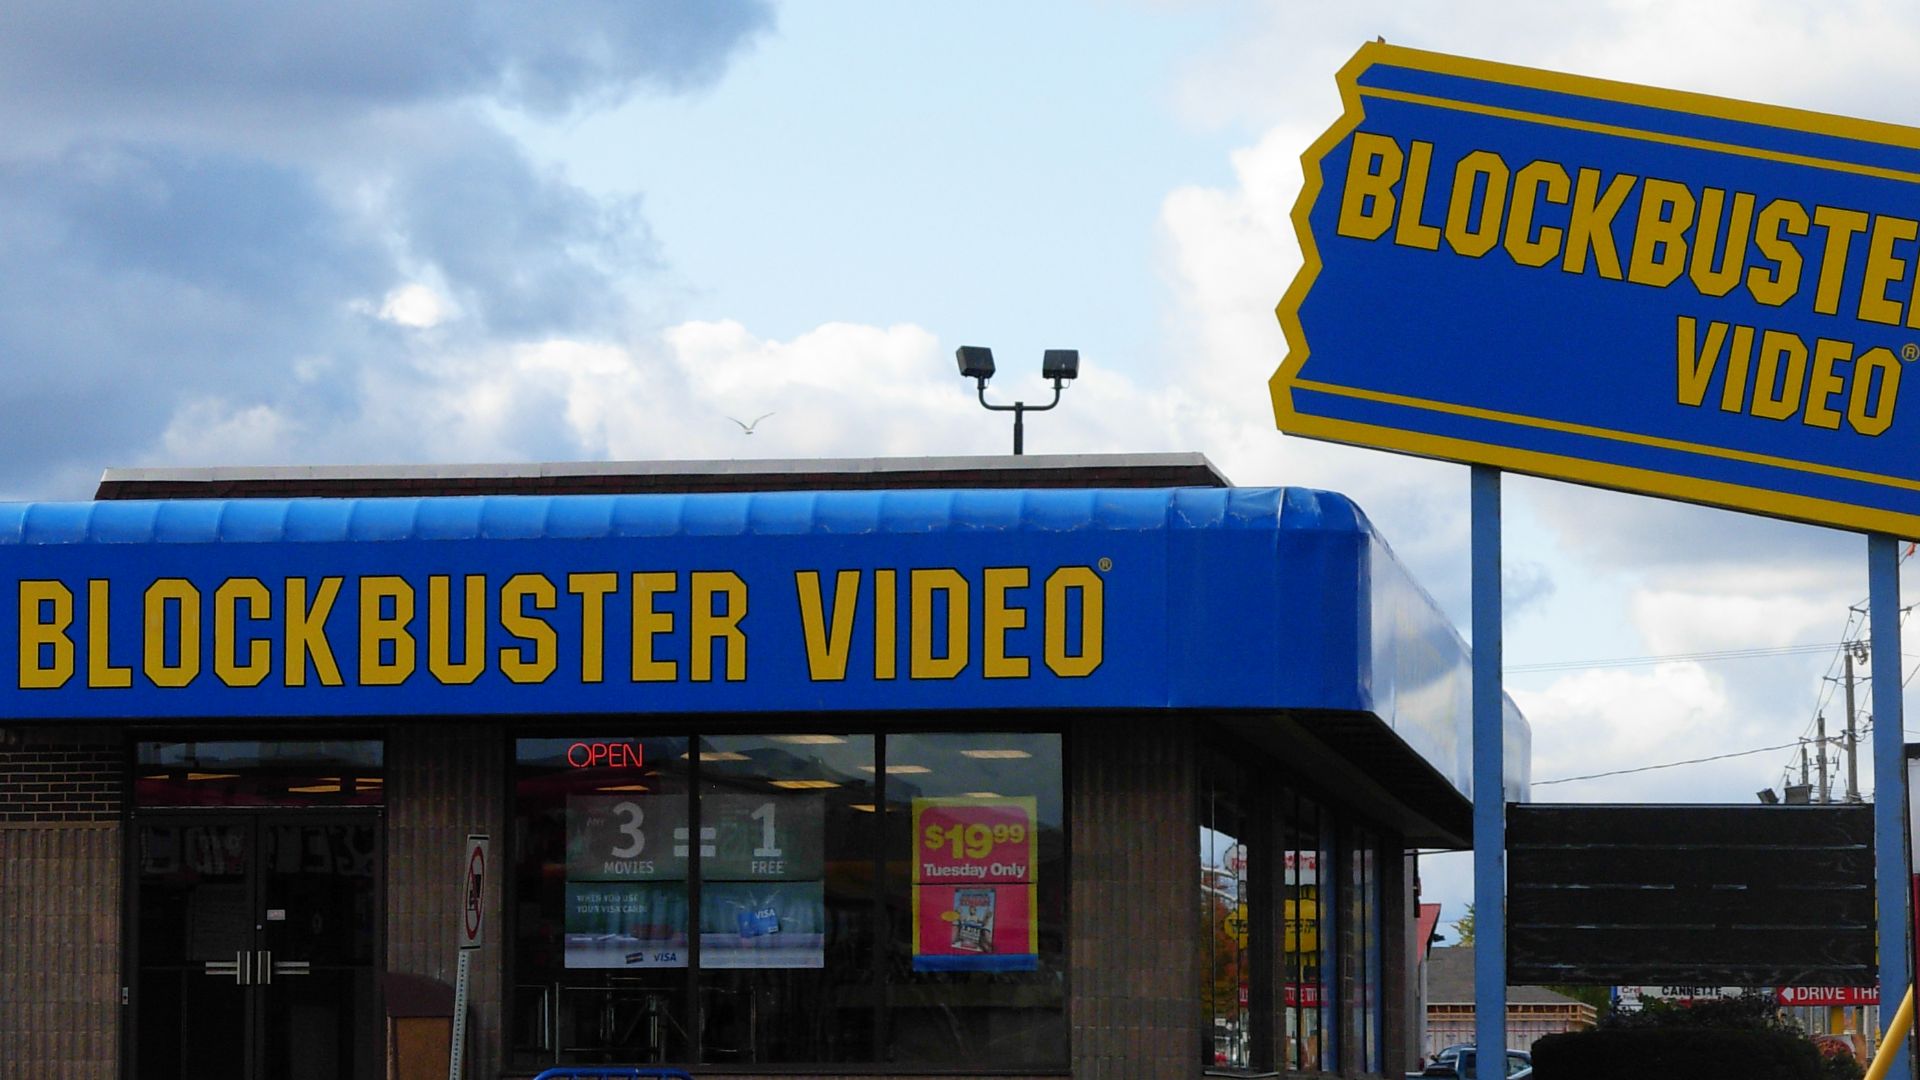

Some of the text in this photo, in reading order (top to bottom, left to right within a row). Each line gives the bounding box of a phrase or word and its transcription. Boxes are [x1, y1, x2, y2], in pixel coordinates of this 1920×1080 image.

[18, 570, 749, 689] BLOCKBUSTER
[567, 741, 644, 768] OPEN
[611, 801, 645, 859] 3
[751, 803, 782, 857] 1
[604, 860, 786, 875] MOVIES FREE
[924, 863, 1026, 878] Tuesday Only
[755, 907, 776, 919] VISA
[654, 952, 677, 962] VISA
[1797, 986, 1846, 1000] DRIVE
